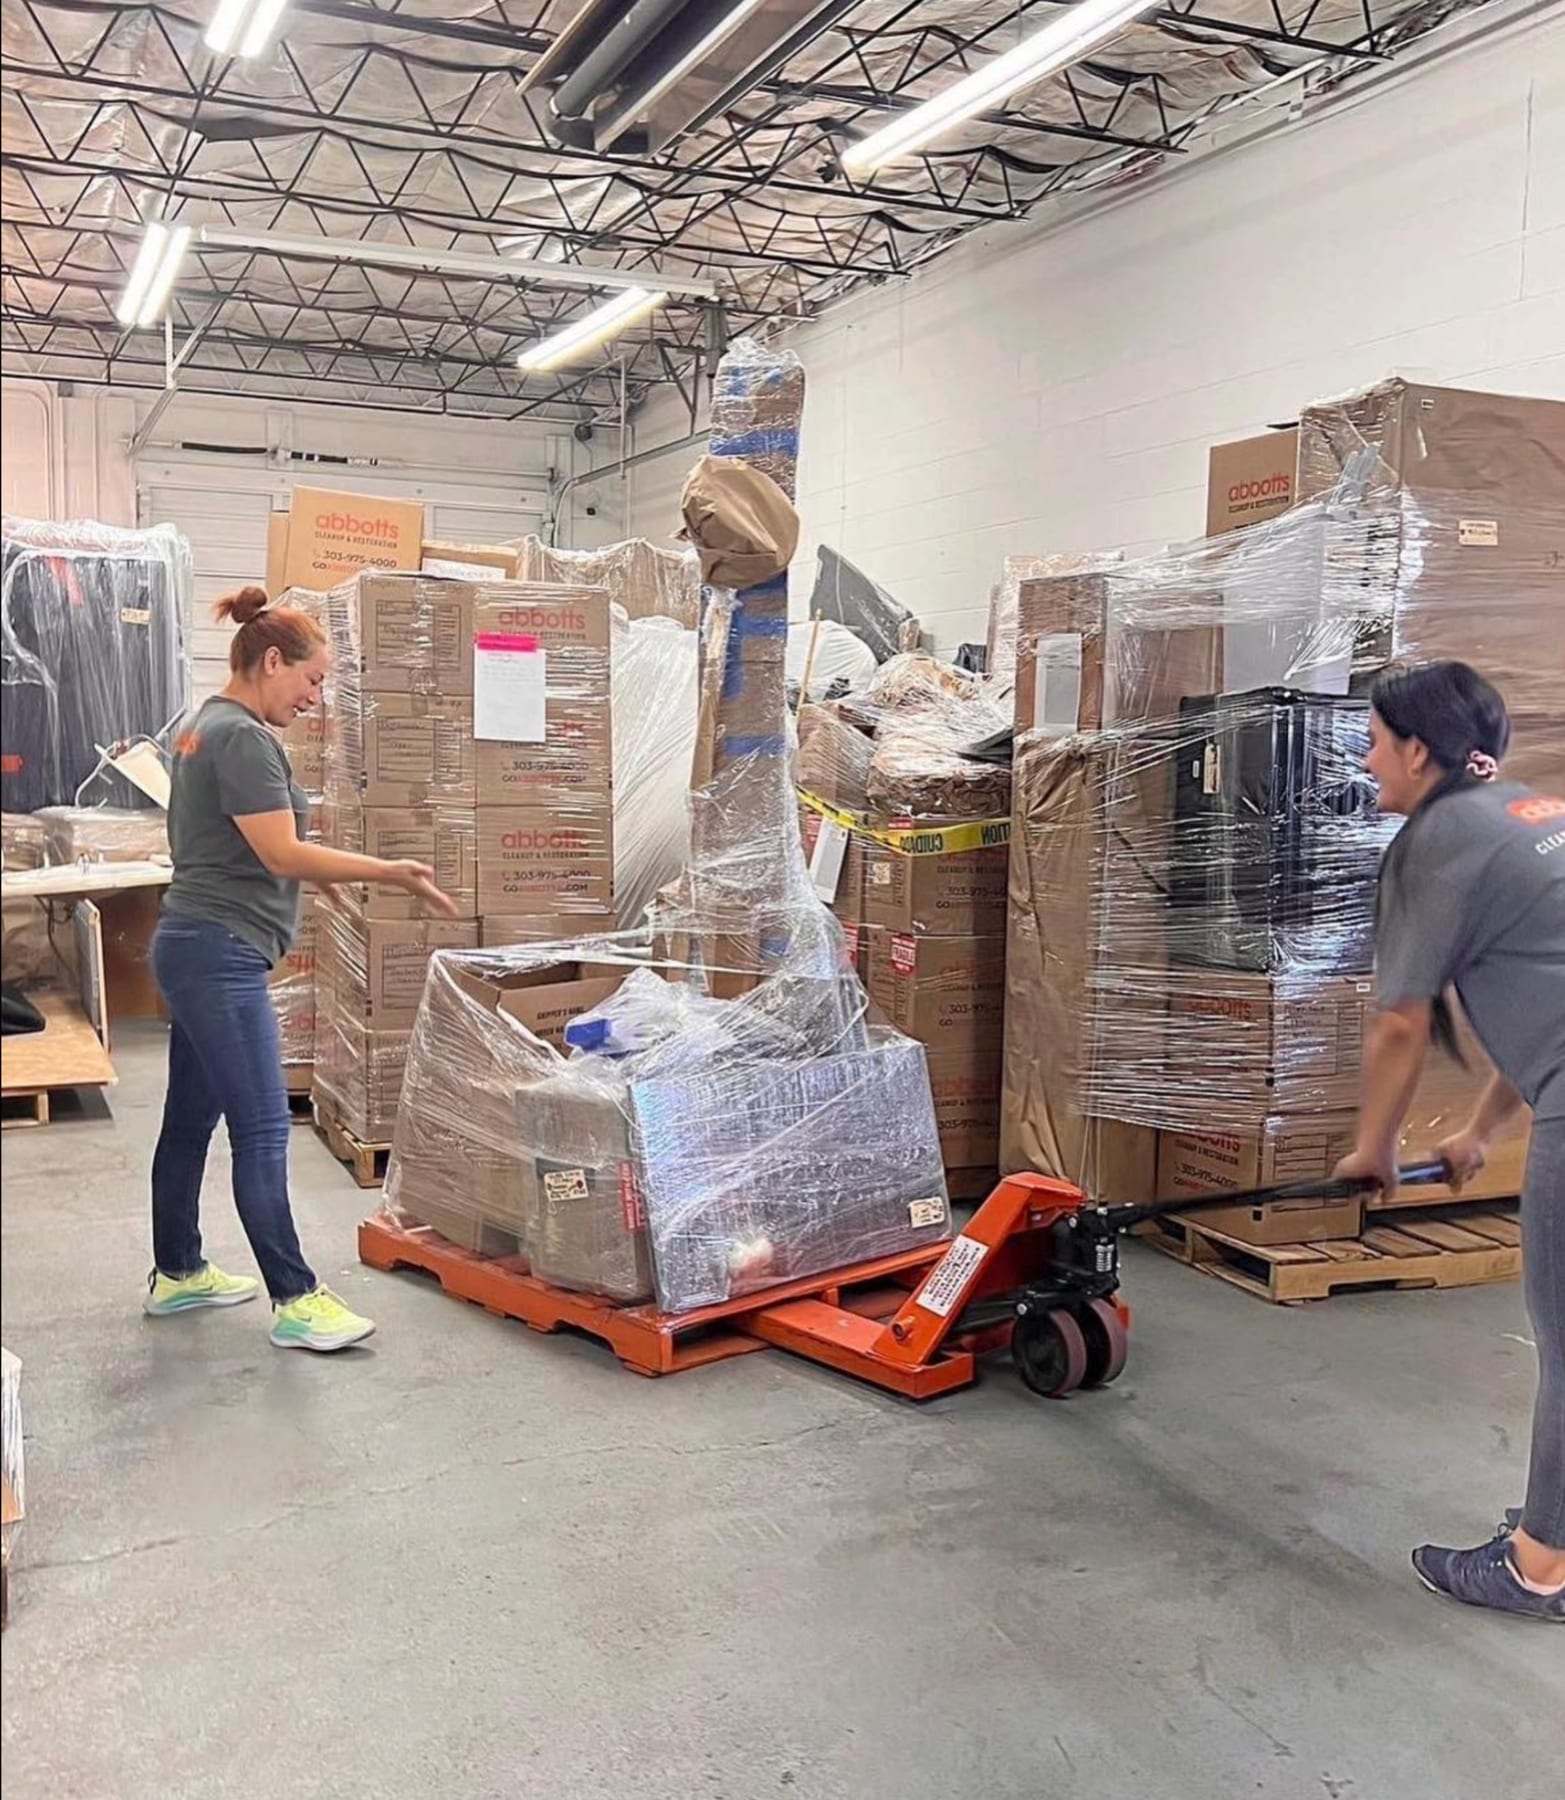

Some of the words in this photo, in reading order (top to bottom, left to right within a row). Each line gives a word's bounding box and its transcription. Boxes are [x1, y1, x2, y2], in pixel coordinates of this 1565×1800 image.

[315, 512, 399, 540] abbotts
[322, 550, 397, 568] 303-975-4000
[499, 606, 586, 630] abbotts
[502, 829, 590, 850] abbotts
